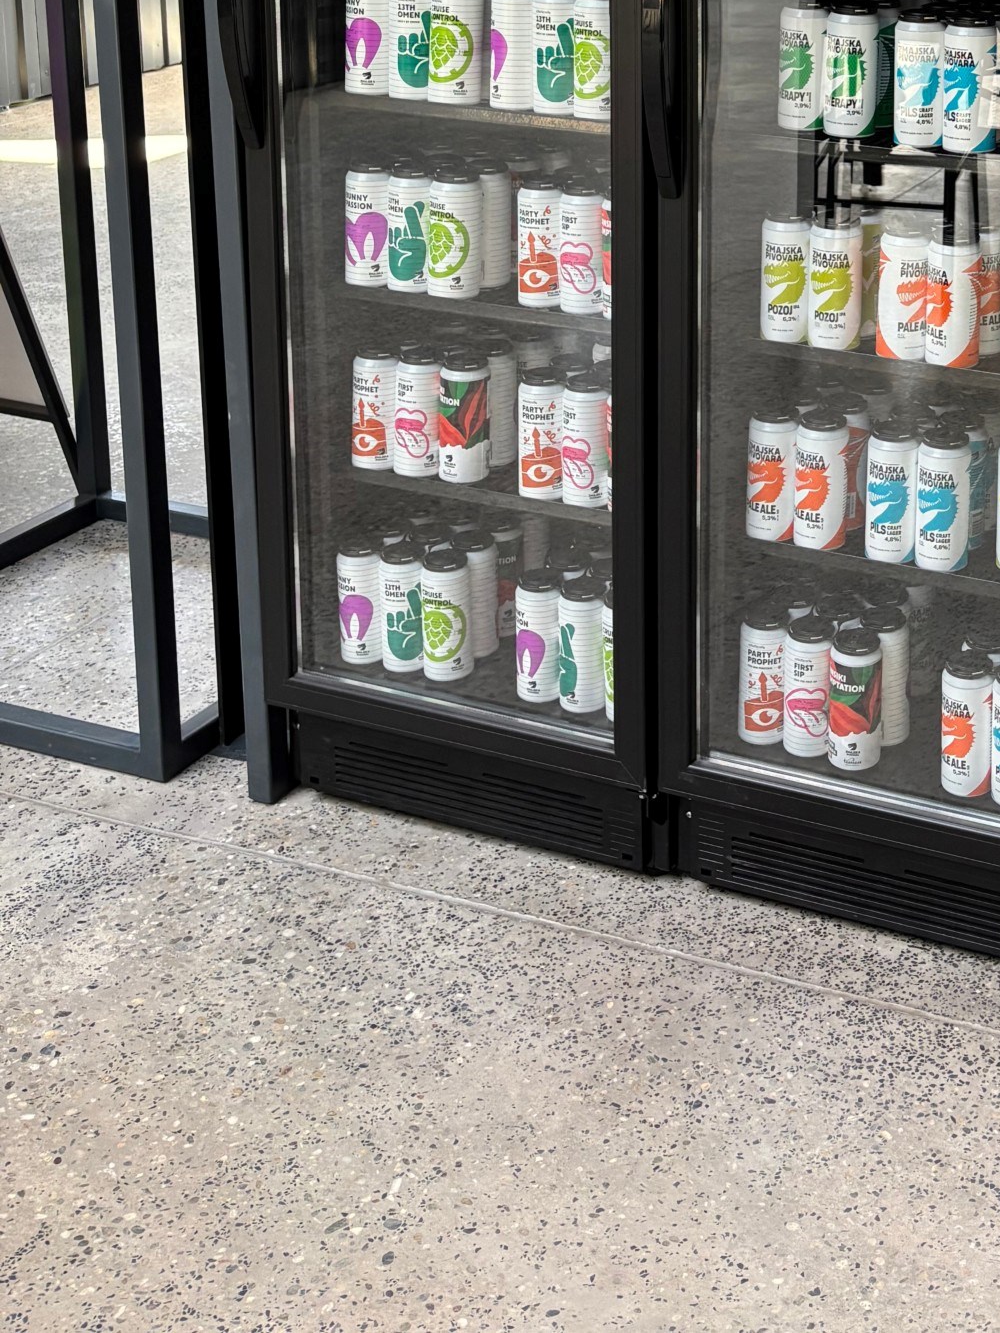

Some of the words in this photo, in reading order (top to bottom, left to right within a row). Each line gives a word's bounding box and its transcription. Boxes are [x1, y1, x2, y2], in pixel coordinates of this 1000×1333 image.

[536, 23, 556, 31] OMEN
[900, 106, 917, 118] PILS
[520, 209, 539, 217] PARTY
[520, 217, 550, 225] PROPHET
[562, 216, 578, 224] FIRST
[766, 244, 802, 254] ZMAJSKA
[766, 252, 804, 261] PIVOVARA
[812, 250, 849, 261] ZMAJSKA
[812, 258, 850, 269] PIVOVARA
[768, 304, 792, 315] POZOJ
[814, 310, 839, 322] POZOJ
[897, 322, 919, 332] PALE
[931, 329, 943, 340] ALE
[398, 383, 414, 392] FIRST
[522, 405, 544, 413] PARTY
[522, 412, 554, 421] PROPHET
[870, 462, 905, 474] ZMAJSKA
[869, 468, 906, 481] PIVOVARA
[920, 468, 954, 481] ZMAJSKA
[919, 476, 955, 489] PIVOVARA
[760, 503, 776, 514] ALE
[805, 511, 820, 522] ALE
[870, 521, 886, 534] PILS
[920, 529, 935, 542] PILS
[385, 590, 406, 598] OMEN
[748, 649, 772, 658] PARTY
[748, 657, 781, 665] PROPHET
[794, 663, 814, 671] FIRST
[951, 760, 966, 769] ALE
